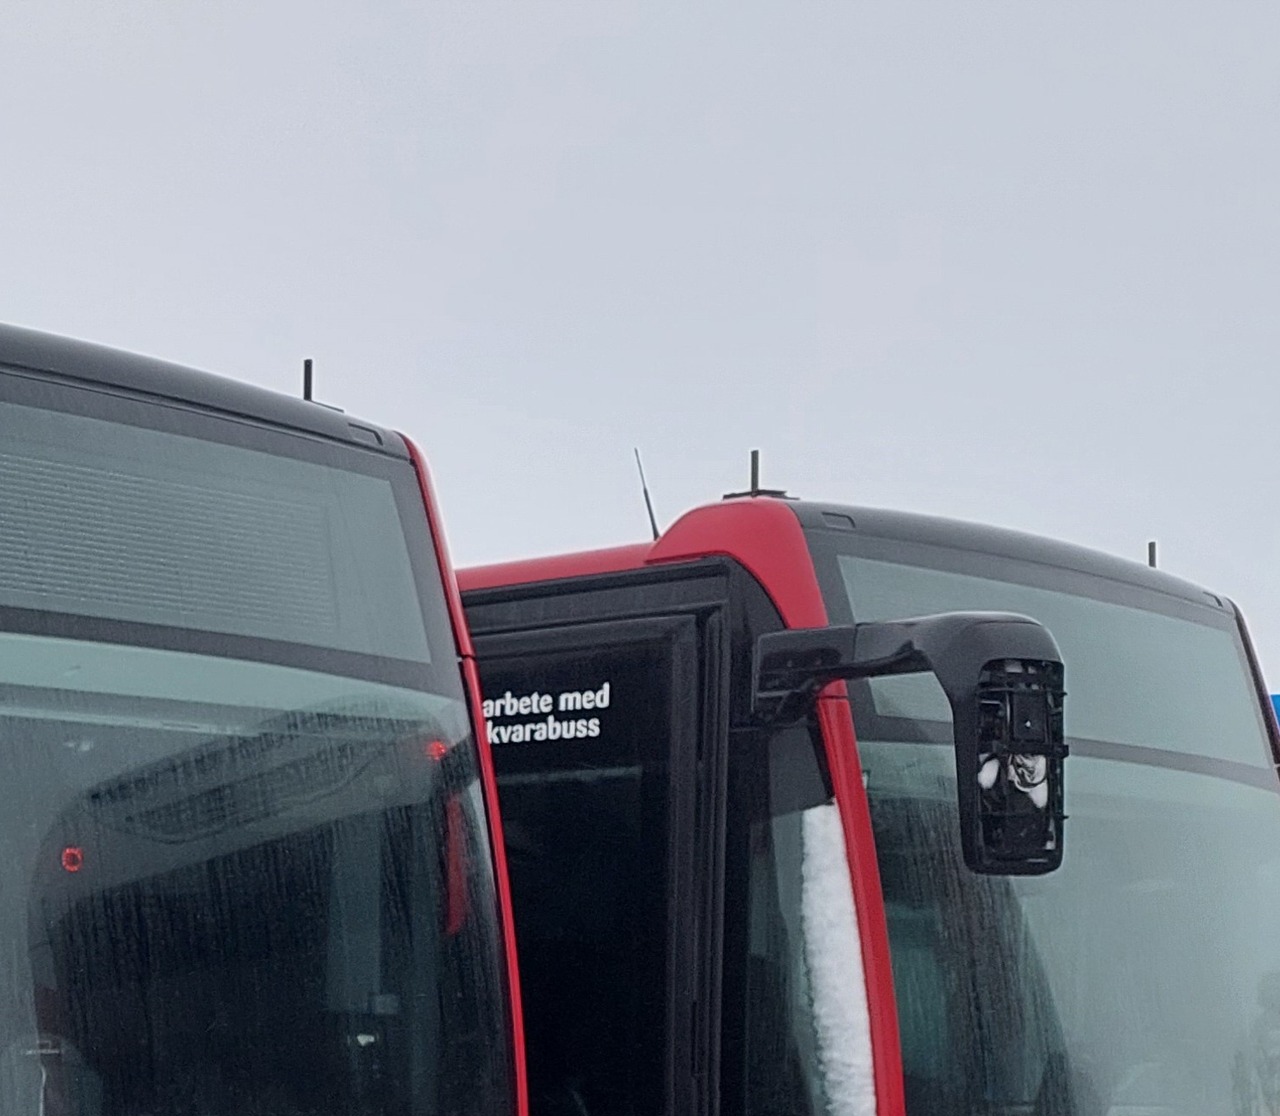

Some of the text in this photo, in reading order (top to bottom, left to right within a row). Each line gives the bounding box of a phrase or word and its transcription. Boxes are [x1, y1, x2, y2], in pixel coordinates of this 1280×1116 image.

[482, 681, 610, 718] arbete med
[486, 714, 600, 745] kvarabuss
